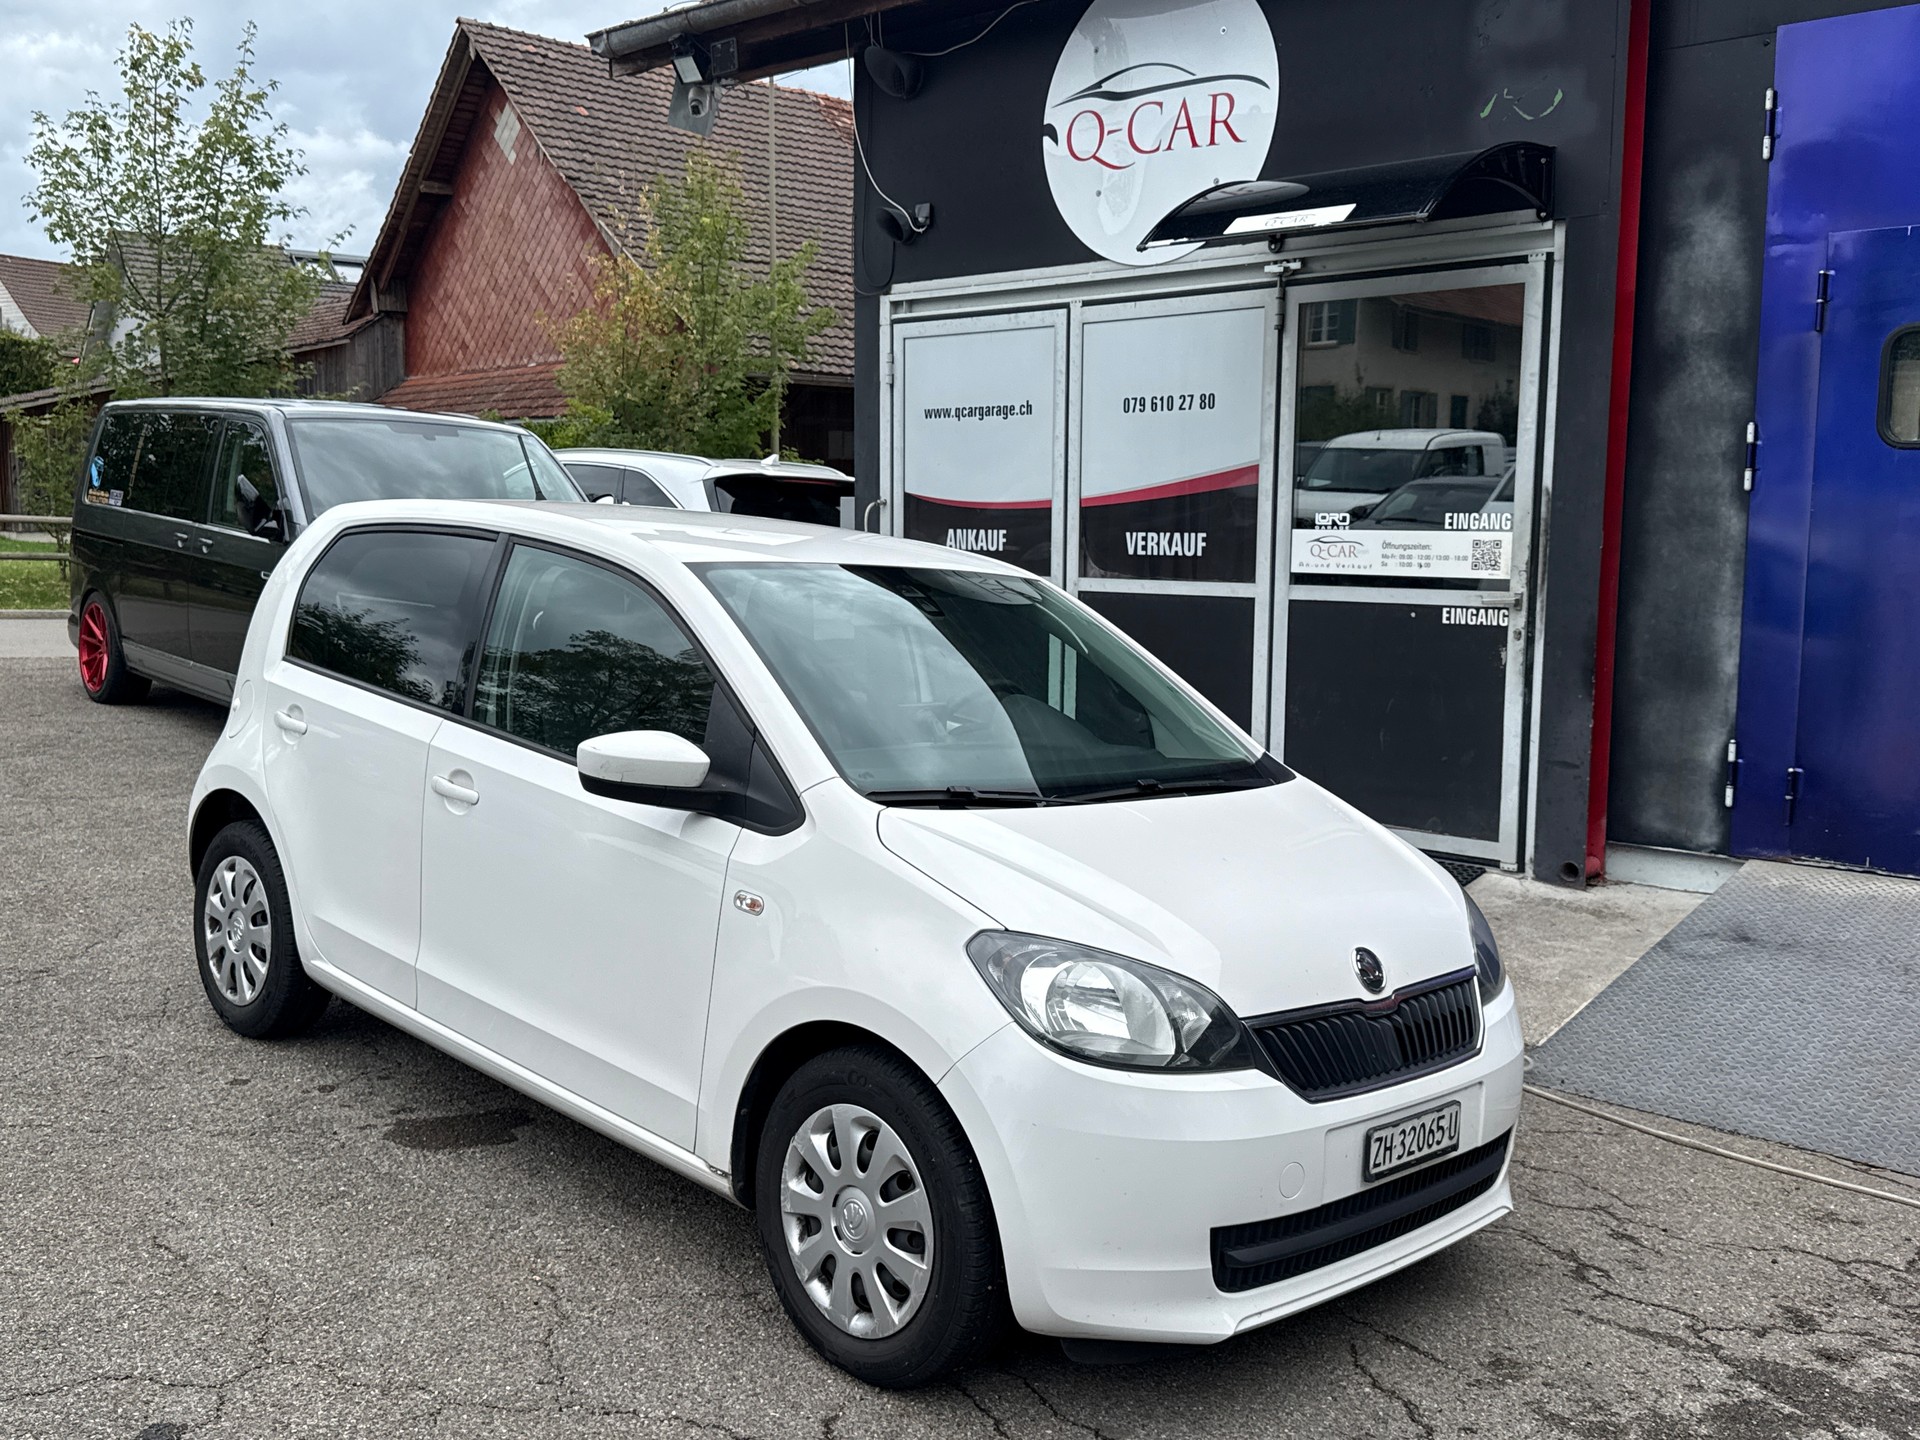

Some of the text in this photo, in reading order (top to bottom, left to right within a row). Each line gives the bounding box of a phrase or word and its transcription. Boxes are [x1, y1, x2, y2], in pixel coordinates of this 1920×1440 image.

[1065, 91, 1247, 170] Q-CAR
[924, 400, 1033, 421] www.qcargarage.ch
[1123, 392, 1216, 413] 079 610 27 80
[1315, 512, 1351, 525] LORD
[1444, 512, 1512, 530] EINGANG
[946, 528, 1007, 551] ANKAUF
[1125, 531, 1207, 557] VERKAUF
[1310, 543, 1358, 560] Q-CAR
[1442, 607, 1509, 627] EINGANG
